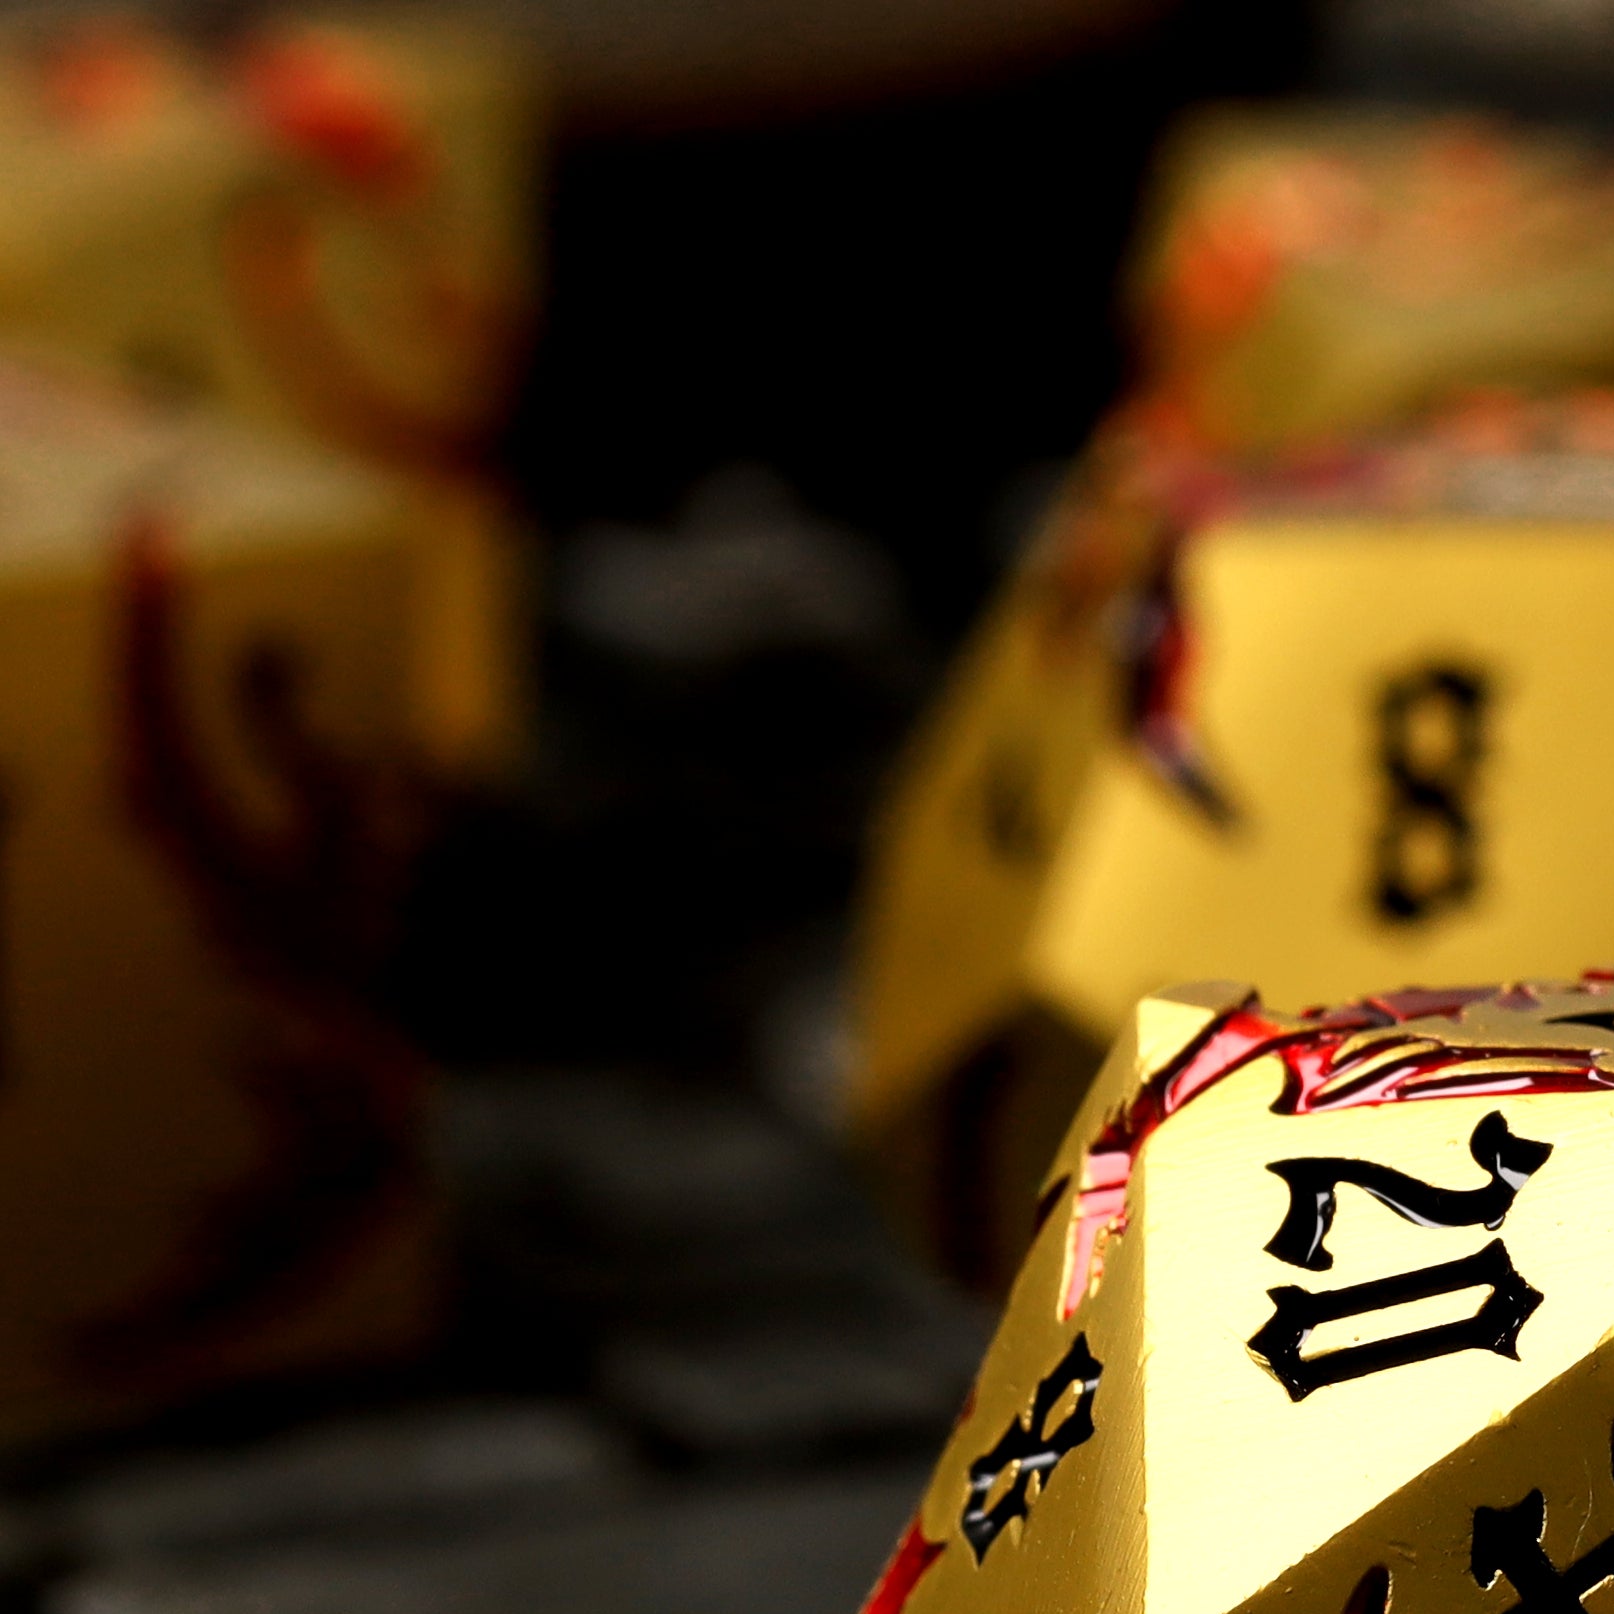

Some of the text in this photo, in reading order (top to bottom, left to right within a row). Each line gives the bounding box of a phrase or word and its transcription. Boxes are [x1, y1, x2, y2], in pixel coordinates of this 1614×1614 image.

[1370, 653, 1497, 928] 8
[1246, 1110, 1554, 1402] 20
[962, 1332, 1104, 1564] 8
